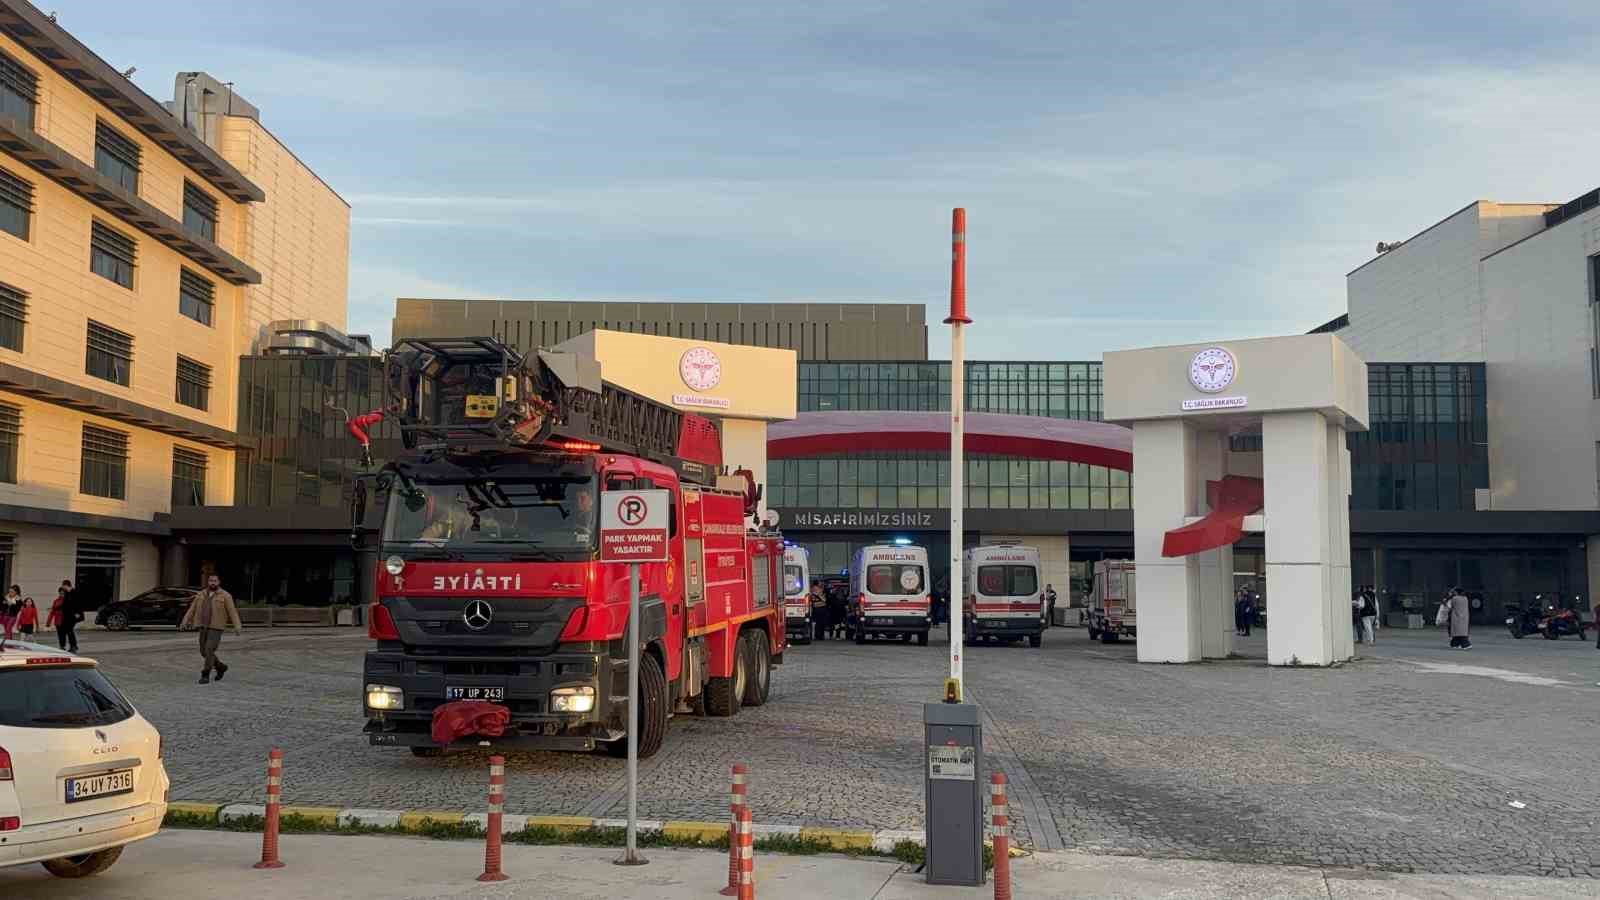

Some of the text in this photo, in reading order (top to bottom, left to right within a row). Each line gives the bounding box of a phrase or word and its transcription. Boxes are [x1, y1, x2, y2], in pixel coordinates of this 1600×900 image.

[794, 511, 932, 526] MİSAFİRİMİZSİNİZ
[604, 534, 664, 544] PARK YAPMAK
[612, 545, 653, 554] YASAKTIR
[453, 688, 501, 698] 17 UP 243
[93, 746, 119, 755] CLIO
[75, 773, 131, 796] 34 UY 7316
